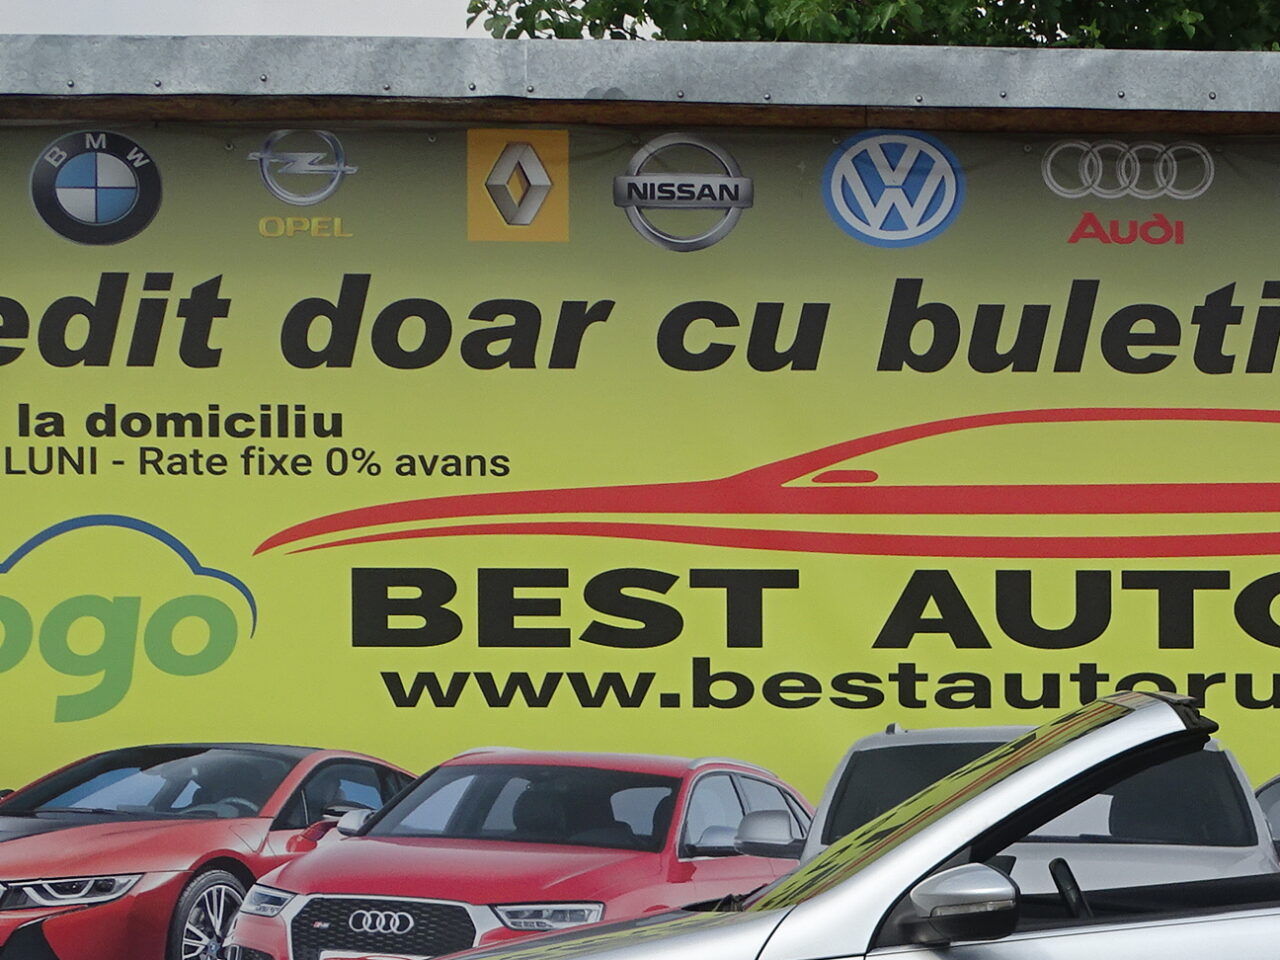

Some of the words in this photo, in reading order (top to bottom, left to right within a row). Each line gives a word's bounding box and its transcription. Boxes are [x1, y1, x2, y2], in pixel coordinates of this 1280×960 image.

[626, 182, 740, 202] NISSAN
[257, 214, 356, 242] OPEL
[1065, 211, 1187, 246] Audi
[281, 274, 616, 370] doar
[657, 301, 830, 372] cu
[19, 404, 65, 437] la
[86, 404, 342, 438] domiciliu
[5, 447, 96, 475] LUNI
[140, 447, 227, 475] Rate
[241, 446, 312, 476] fixe
[327, 448, 381, 476] 0%
[396, 455, 509, 476] avans
[352, 568, 799, 648] BEST
